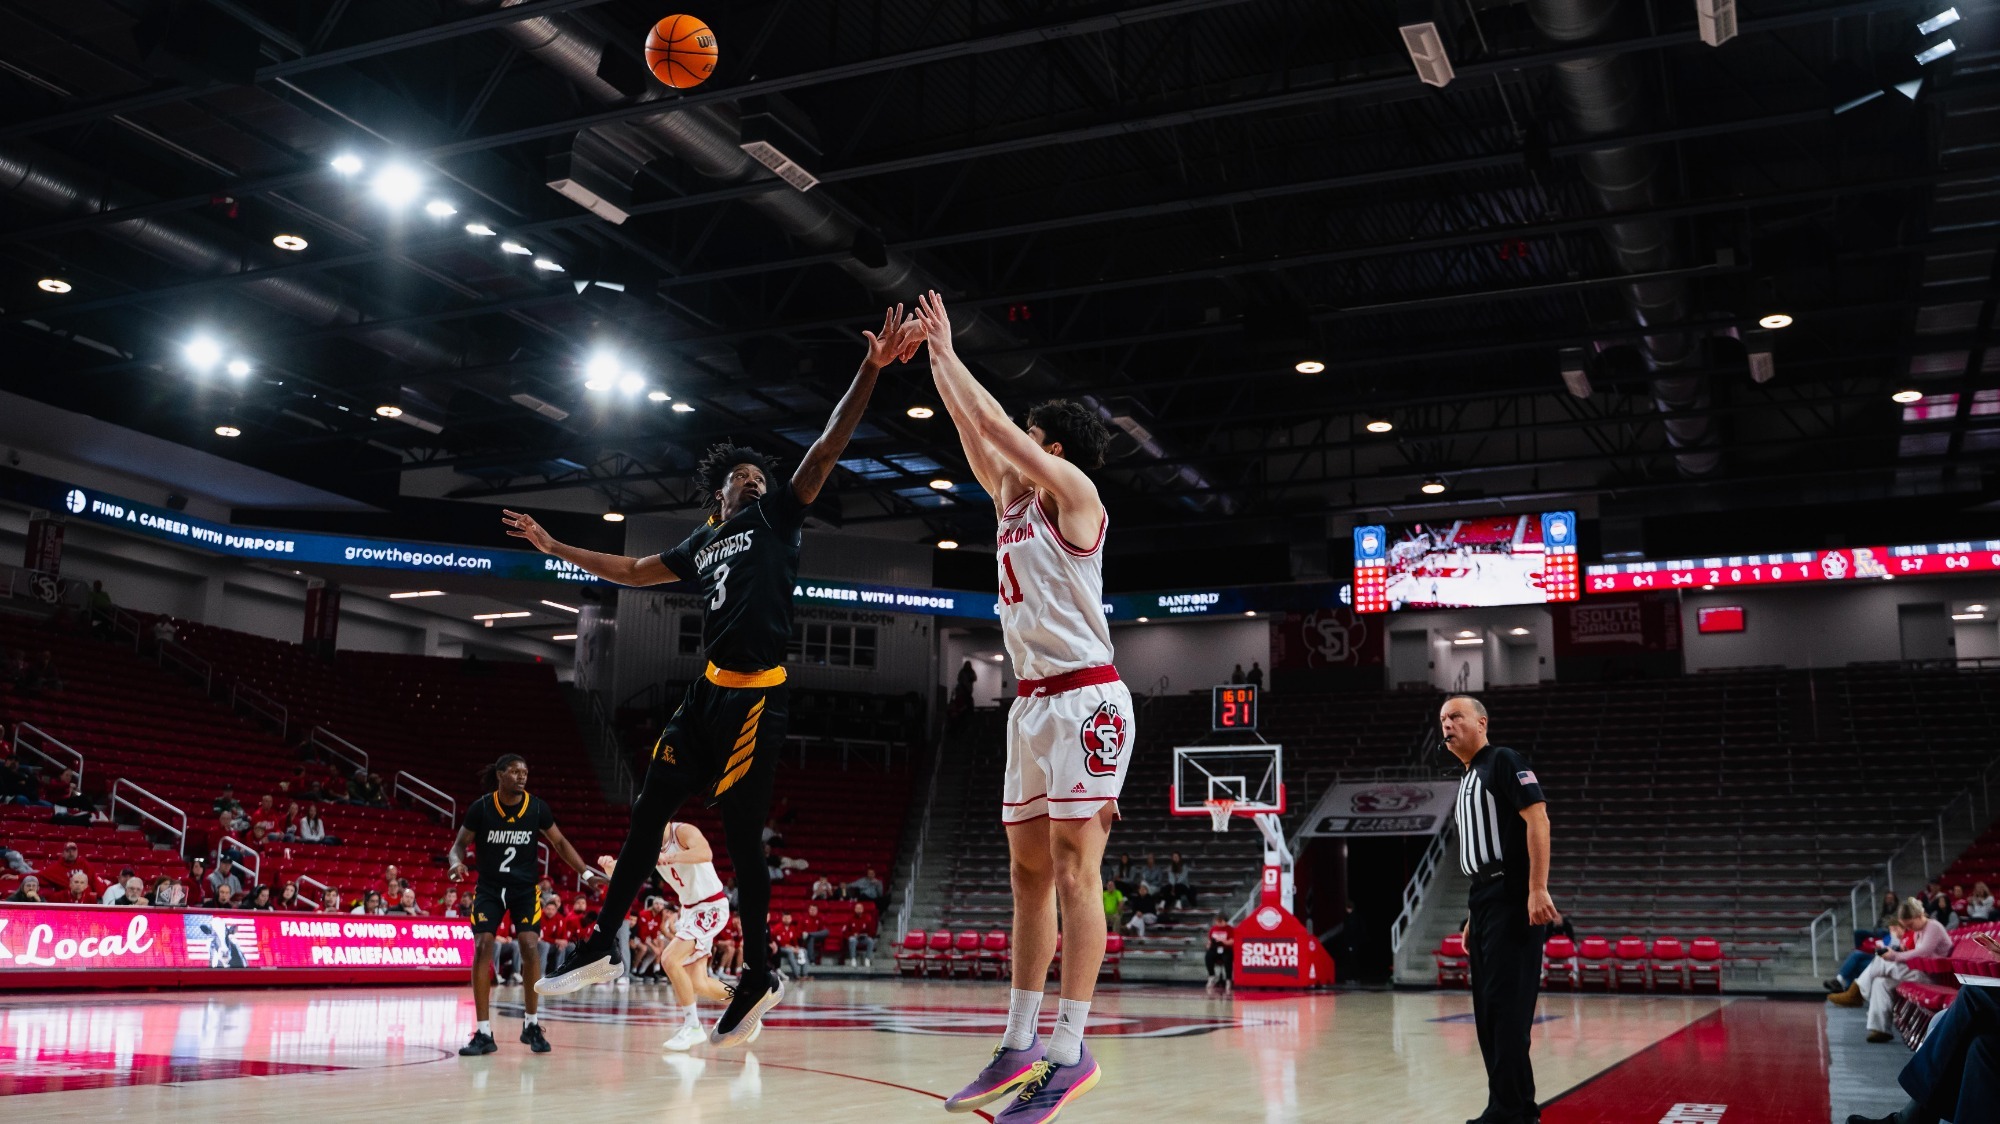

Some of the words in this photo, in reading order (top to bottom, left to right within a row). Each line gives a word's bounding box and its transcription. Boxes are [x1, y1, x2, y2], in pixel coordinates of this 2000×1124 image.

[92, 500, 124, 519] FIND
[126, 510, 137, 522] A
[139, 513, 189, 536] CAREER
[191, 525, 223, 545] WITH
[225, 535, 295, 553] PURPOSE
[345, 546, 492, 569] growthegood.com
[695, 529, 754, 575] PANTHERS
[545, 558, 589, 574] SANF
[1710, 570, 1719, 583] 2
[1731, 569, 1741, 582] 0
[1752, 567, 1761, 580] 1
[1771, 566, 1782, 579] 0
[1800, 564, 1809, 578] 1
[557, 572, 598, 582] HEALTH
[711, 563, 730, 611] 3
[793, 586, 804, 596] A
[806, 586, 858, 601] CAREER
[861, 591, 894, 604] WITH
[896, 594, 955, 609] PURPOSE
[1158, 593, 1219, 606] SANFORD
[1170, 605, 1207, 613] HEALTH
[1577, 608, 1641, 623] SOUTH
[1578, 620, 1642, 634] DAKOTA
[1222, 702, 1249, 727] 21
[487, 830, 533, 845] PANTHERS
[499, 846, 517, 873] 2
[280, 921, 341, 938] FARMER
[343, 923, 397, 939] OWNED
[412, 924, 450, 939] SINCE
[14, 914, 154, 967] Local
[1241, 942, 1298, 956] SOUTH
[311, 946, 462, 965] PRAIRIEFARMS.COM
[1241, 955, 1298, 967] DAKOTA
